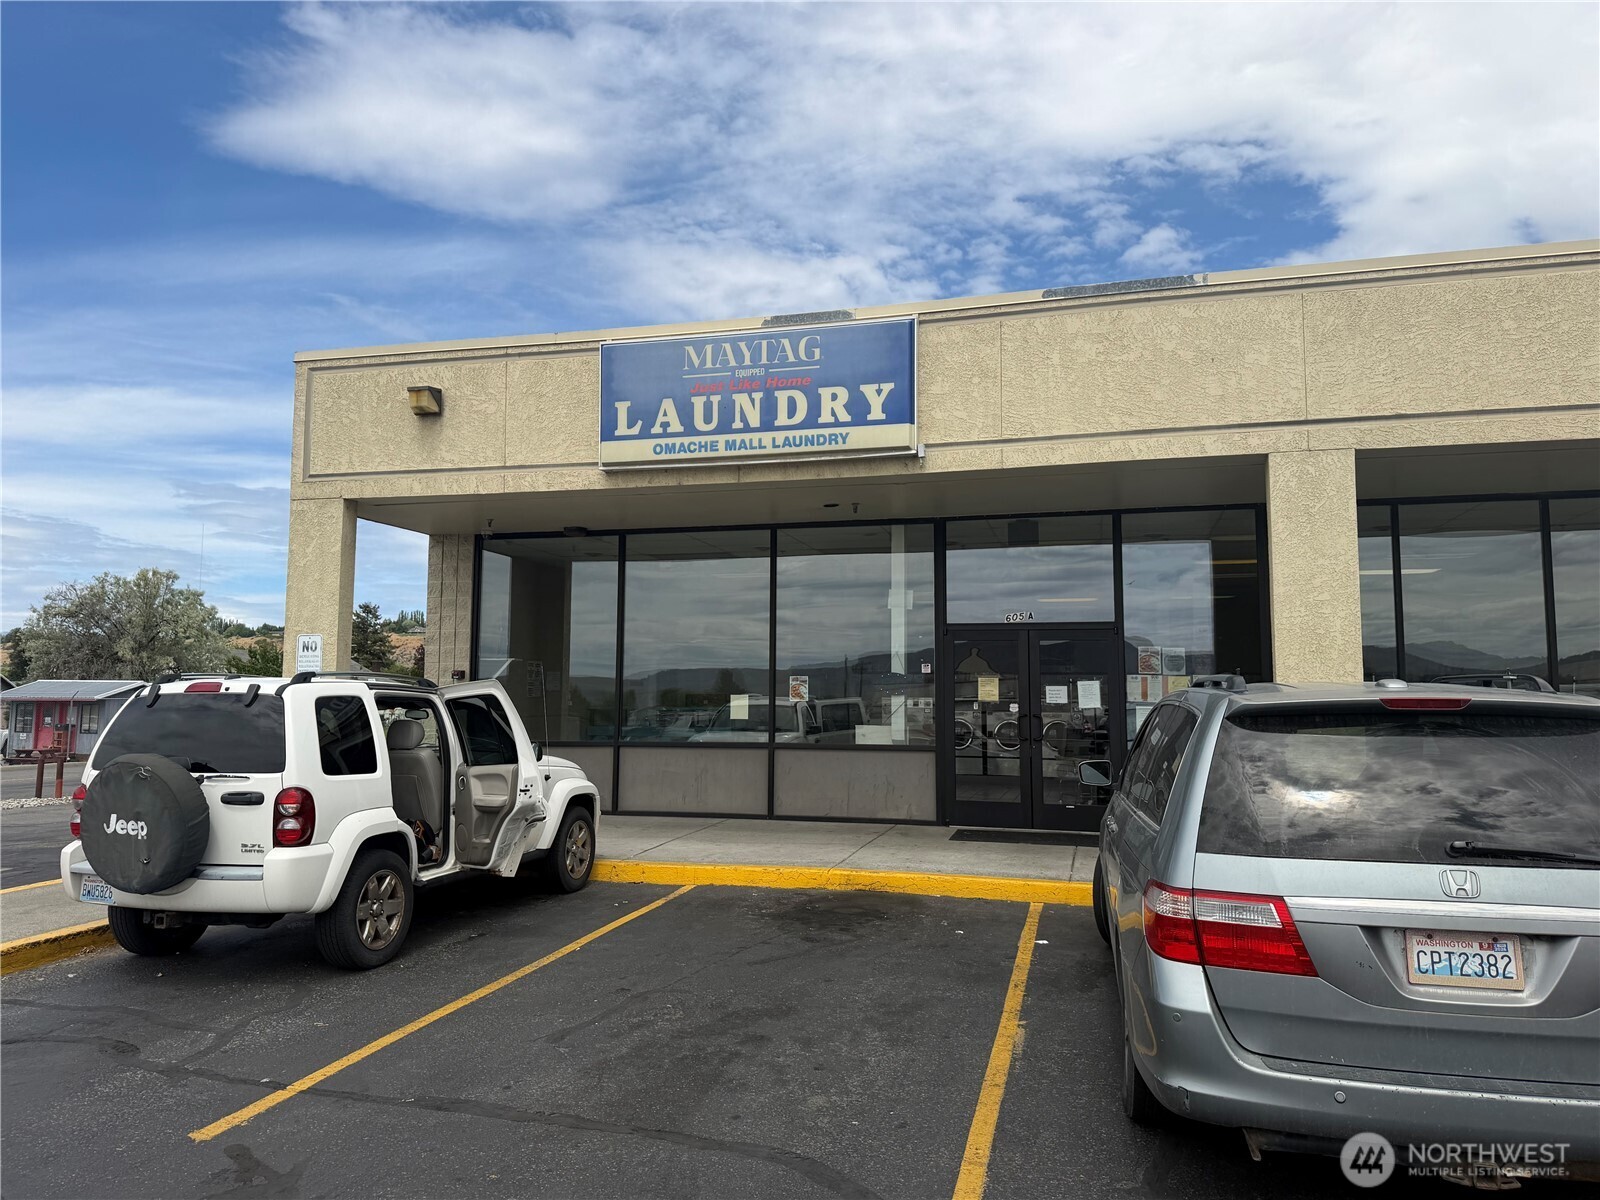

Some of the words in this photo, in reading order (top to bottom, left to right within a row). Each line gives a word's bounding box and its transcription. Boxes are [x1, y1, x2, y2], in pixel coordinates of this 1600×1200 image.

[683, 336, 821, 370] MAYTAG
[735, 367, 765, 378] EQUIPPED
[690, 381, 727, 393] Just
[729, 379, 760, 390] Like
[766, 376, 812, 388] Home
[614, 382, 895, 436] LAUNDRY
[653, 440, 719, 455] OMACHE
[725, 437, 767, 452] MALL
[771, 432, 850, 449] LAUNDRY
[1006, 612, 1024, 622] 605
[1027, 612, 1034, 620] A
[302, 641, 317, 652] NO
[104, 813, 147, 839] Jeep
[1415, 939, 1474, 949] WASHINGTON
[1416, 950, 1514, 979] CPT2382
